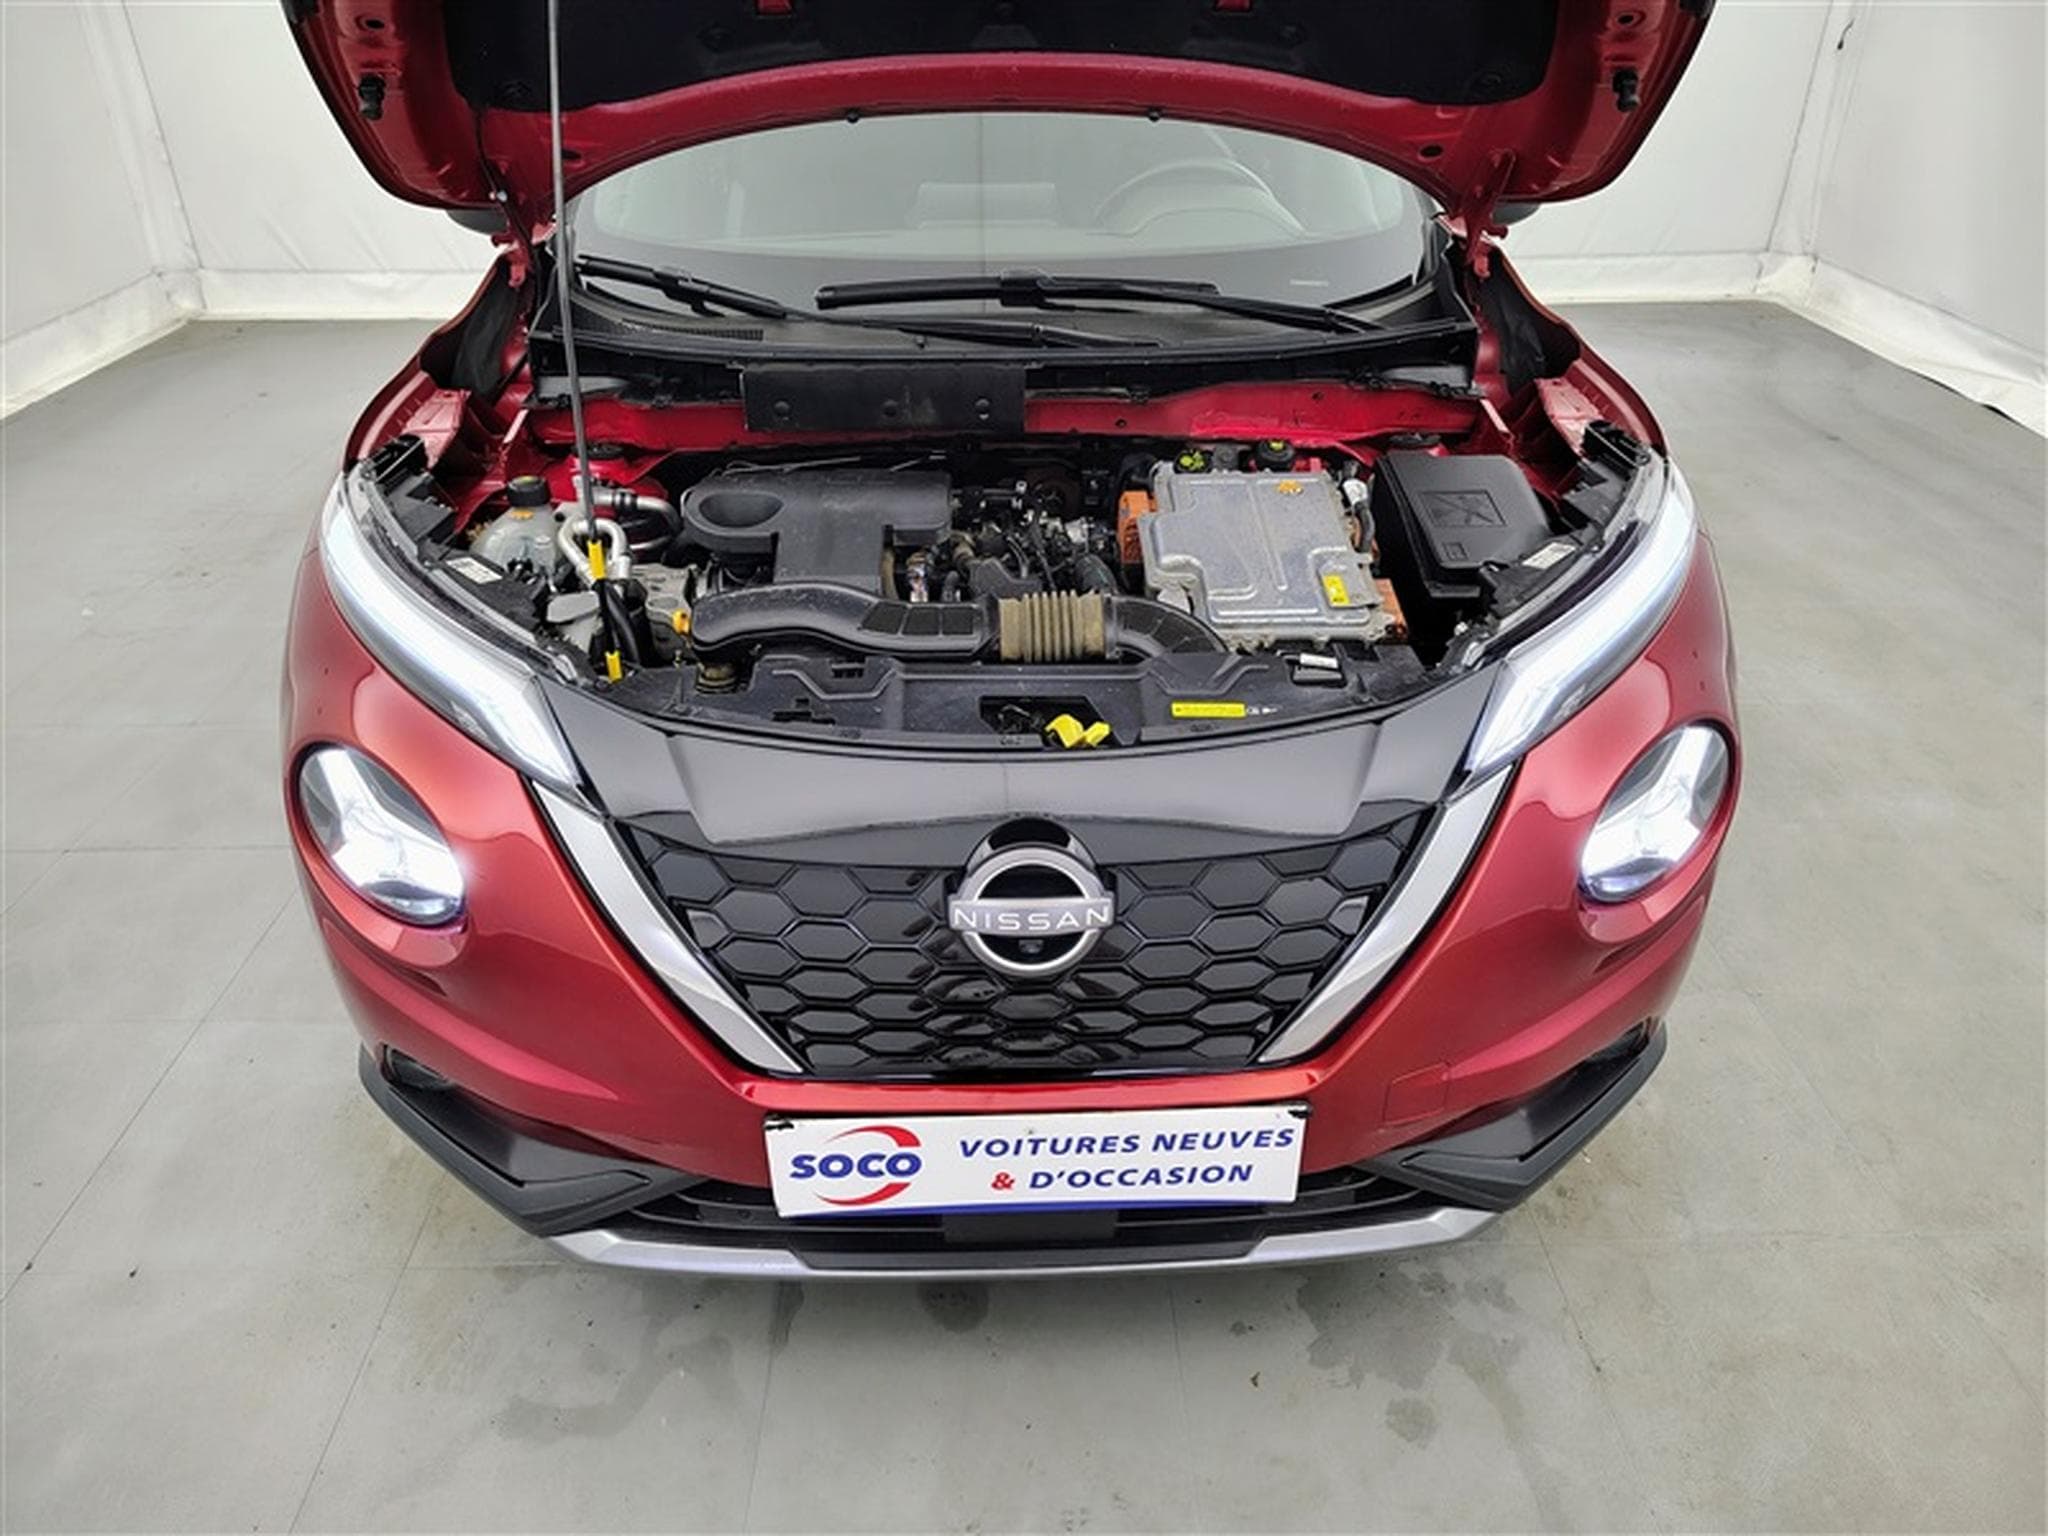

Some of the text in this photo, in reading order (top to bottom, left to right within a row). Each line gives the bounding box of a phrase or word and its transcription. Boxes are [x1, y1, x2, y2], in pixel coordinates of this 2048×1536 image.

[953, 904, 1110, 931] NISSAN
[959, 1128, 1295, 1158] VOITURES NEUVES
[789, 1152, 923, 1180] SOCO
[990, 1164, 1254, 1191] & D'OCCASION
